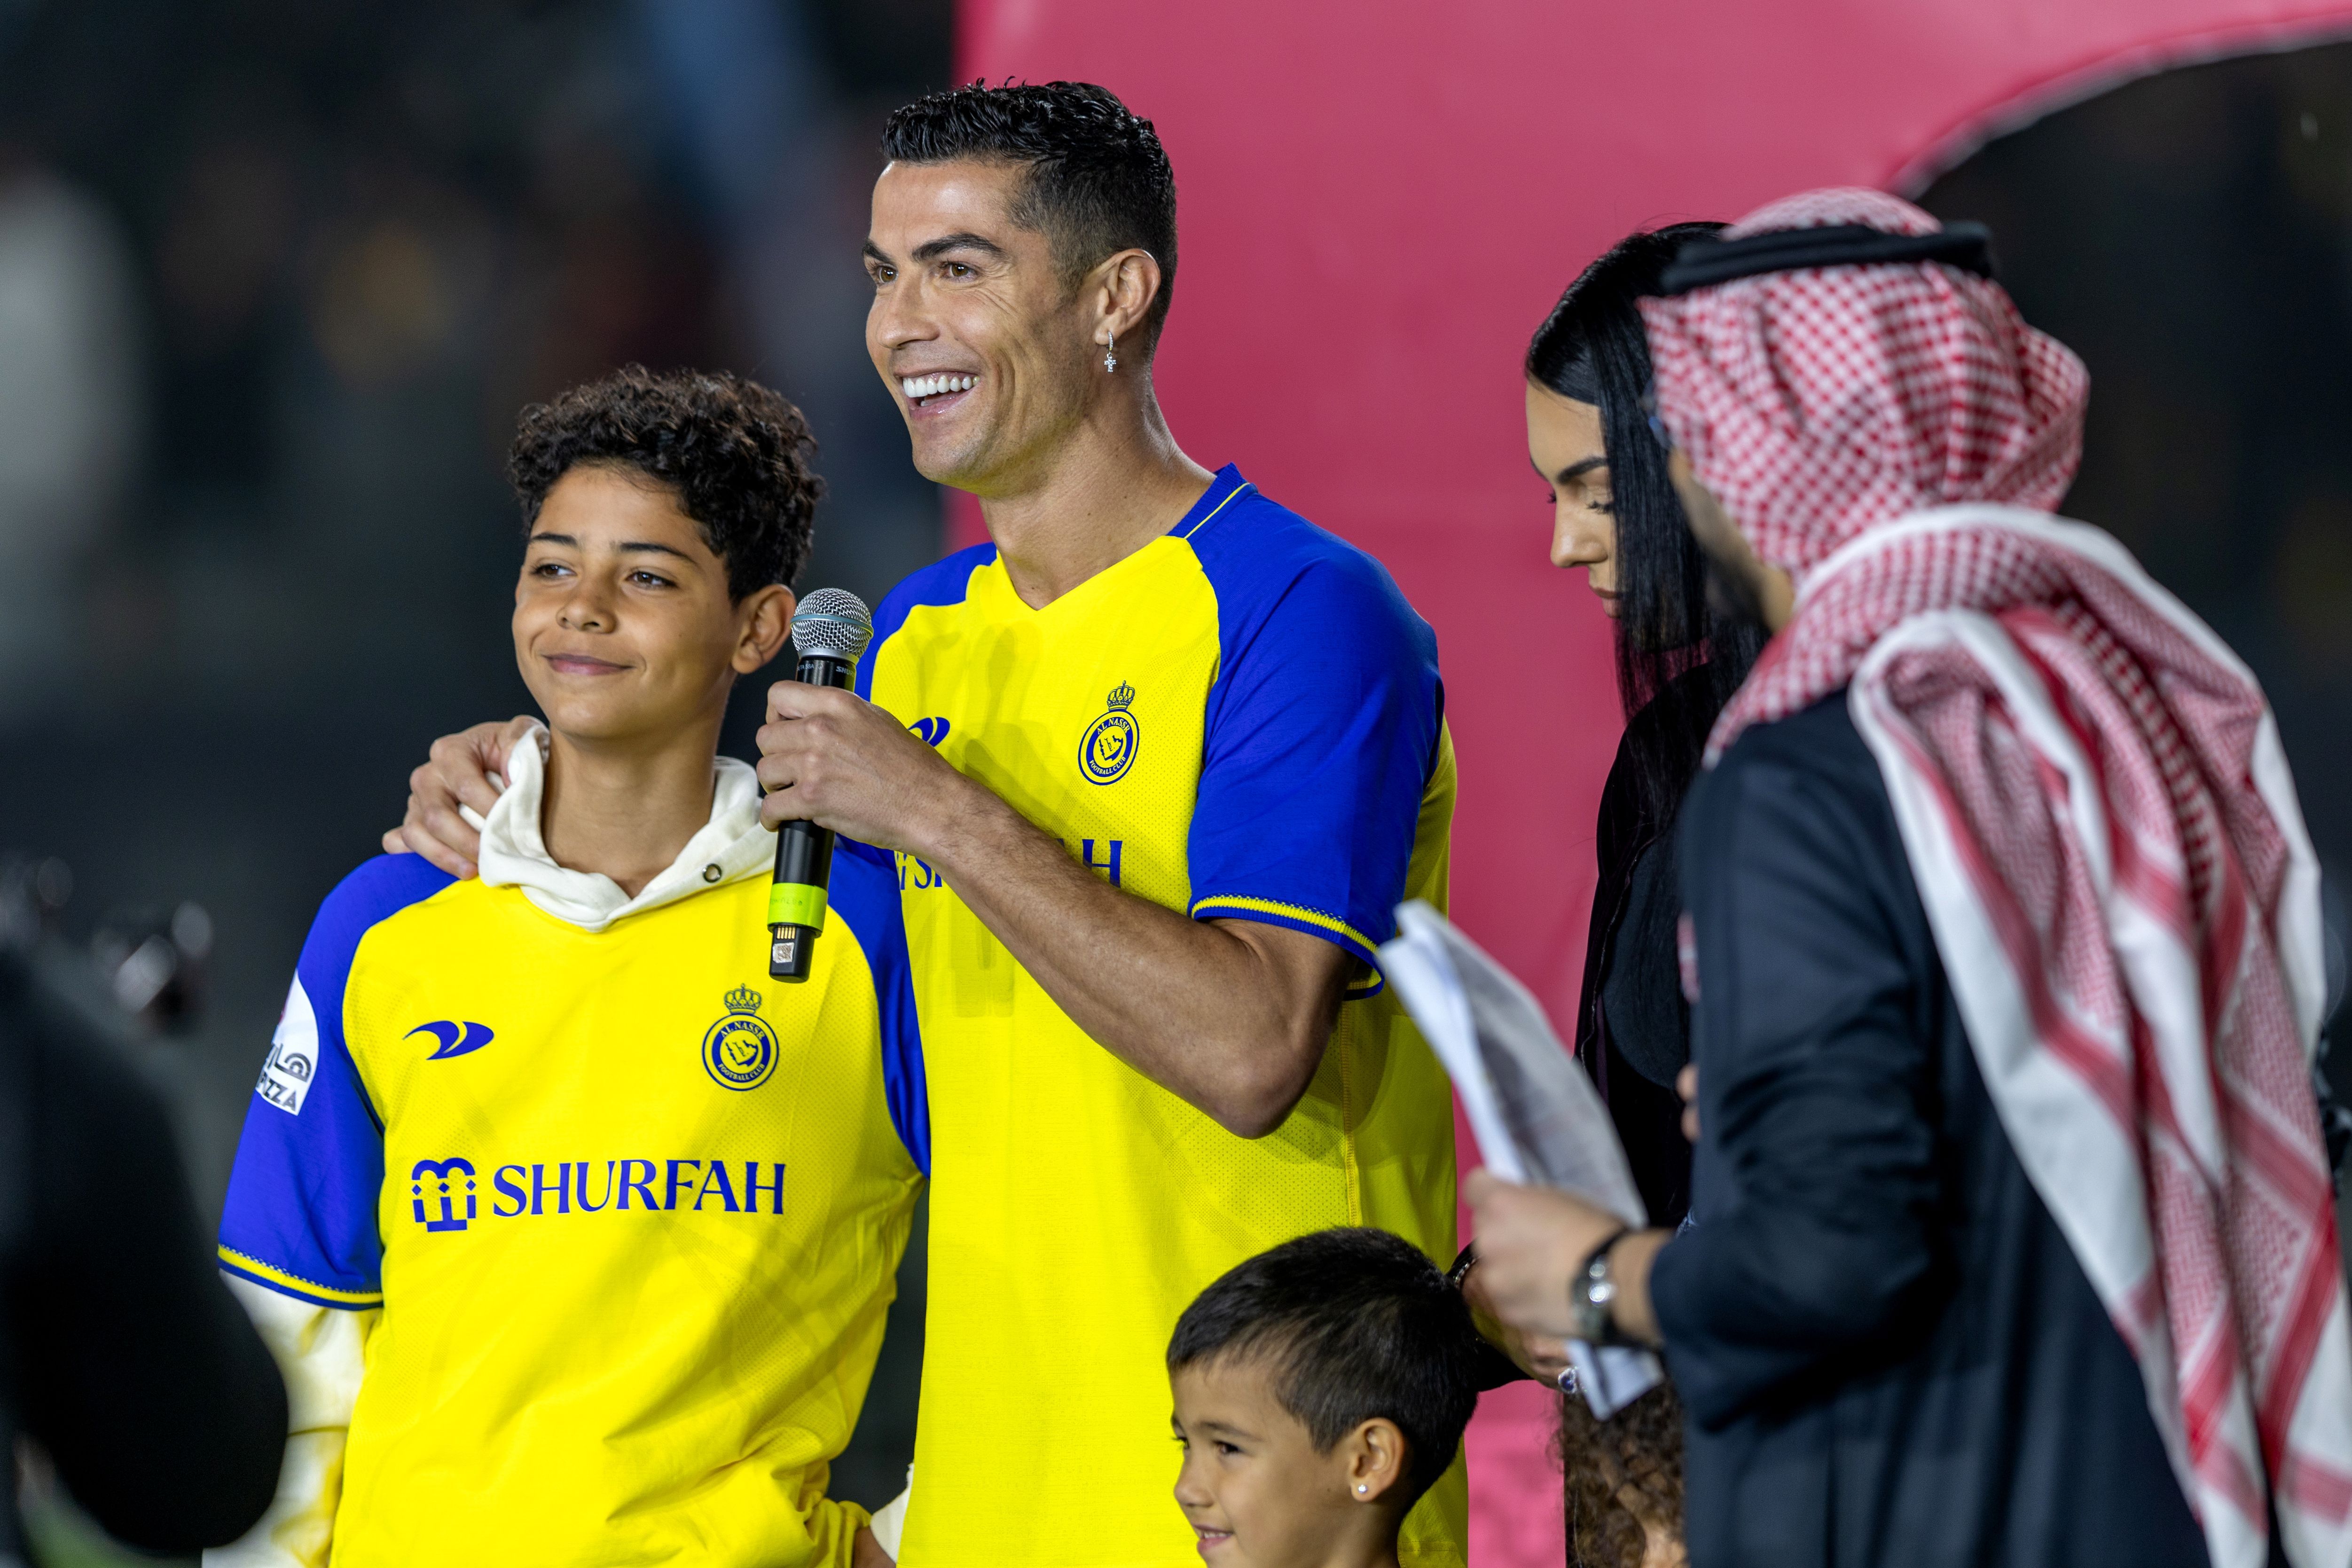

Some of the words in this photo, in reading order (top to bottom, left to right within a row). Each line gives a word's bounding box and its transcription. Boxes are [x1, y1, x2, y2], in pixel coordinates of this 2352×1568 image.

[836, 666, 855, 677] SHUR
[1097, 722, 1107, 735] AL
[1108, 718, 1131, 734] NASSR
[1089, 759, 1113, 775] FOOTBALL
[1113, 756, 1126, 771] CLUB
[720, 1025, 733, 1038] AL
[734, 1021, 766, 1040] NASSR
[717, 1063, 749, 1081] FOOTBALL
[749, 1063, 765, 1079] CLUB
[493, 1159, 786, 1217] SHURFAH
